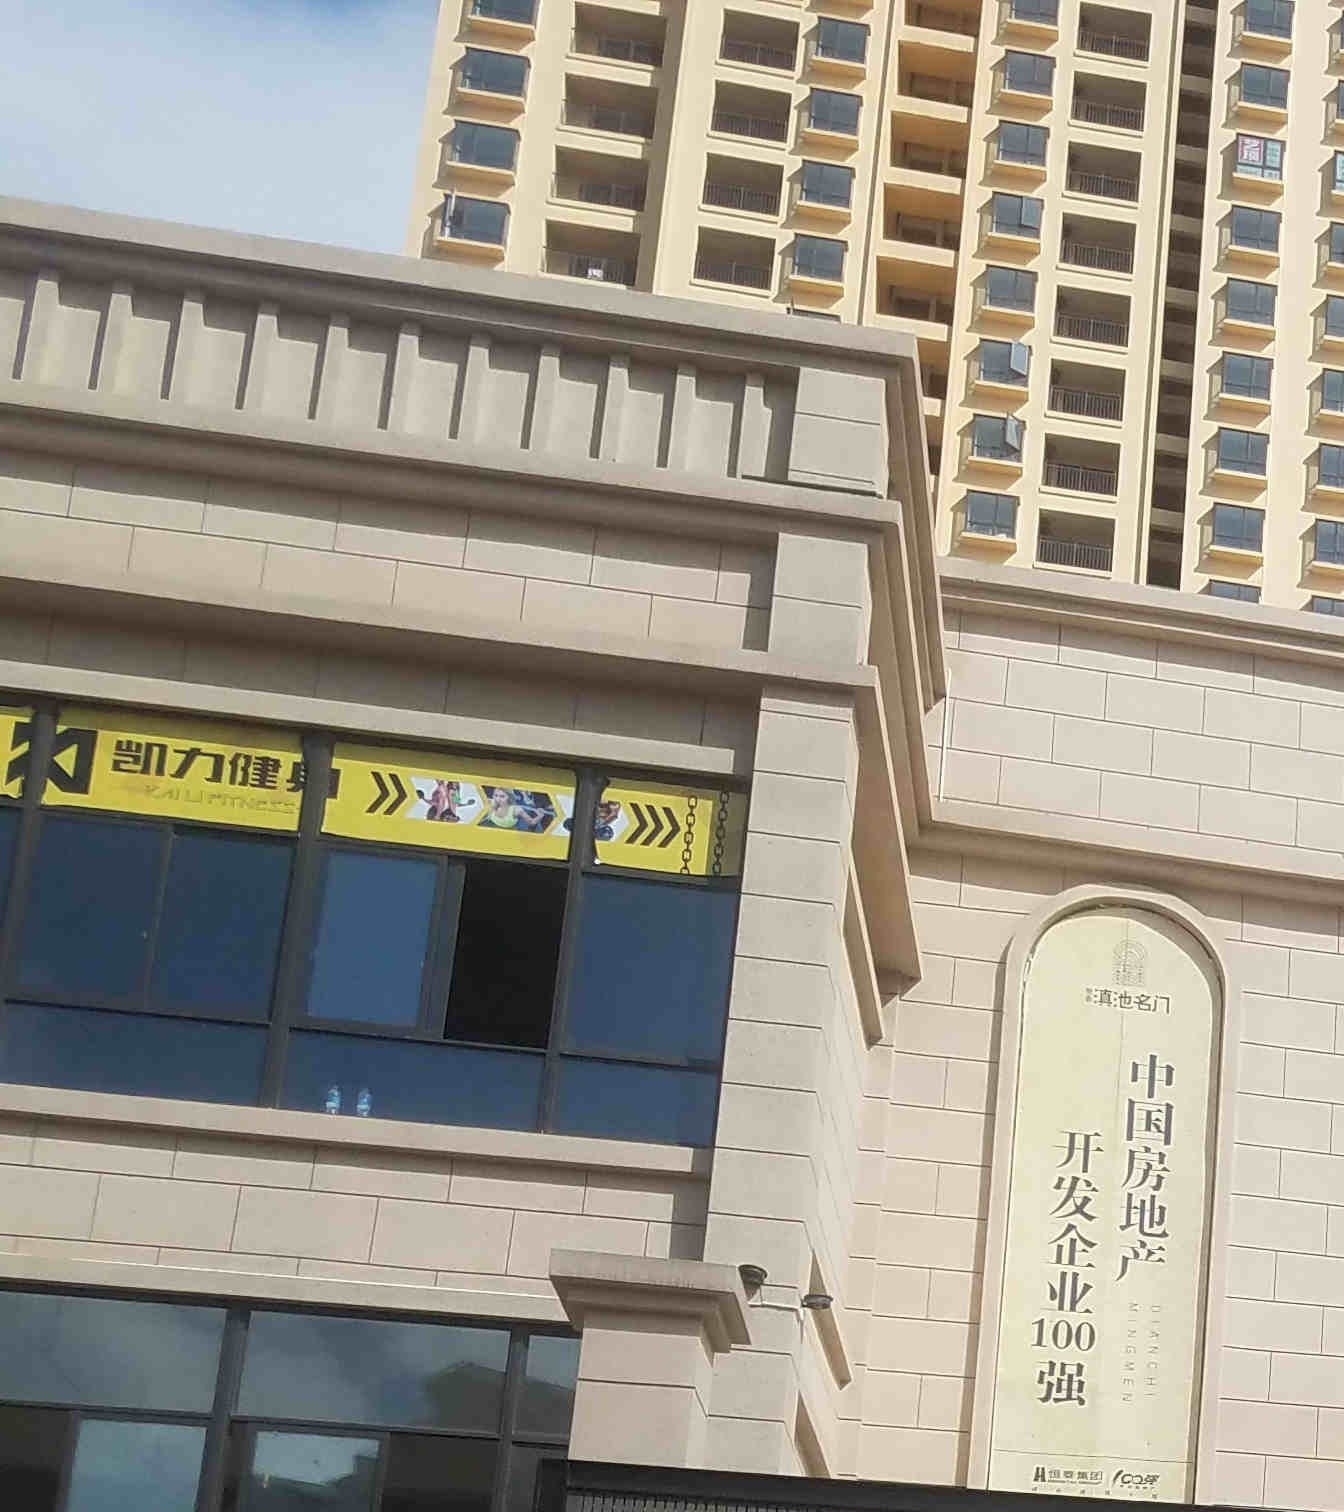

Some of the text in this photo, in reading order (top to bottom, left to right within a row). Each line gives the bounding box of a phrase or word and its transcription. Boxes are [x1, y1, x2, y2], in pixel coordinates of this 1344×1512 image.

[1030, 1128, 1105, 1406] 开发企业100强
[1115, 1053, 1176, 1282] 中国房地产
